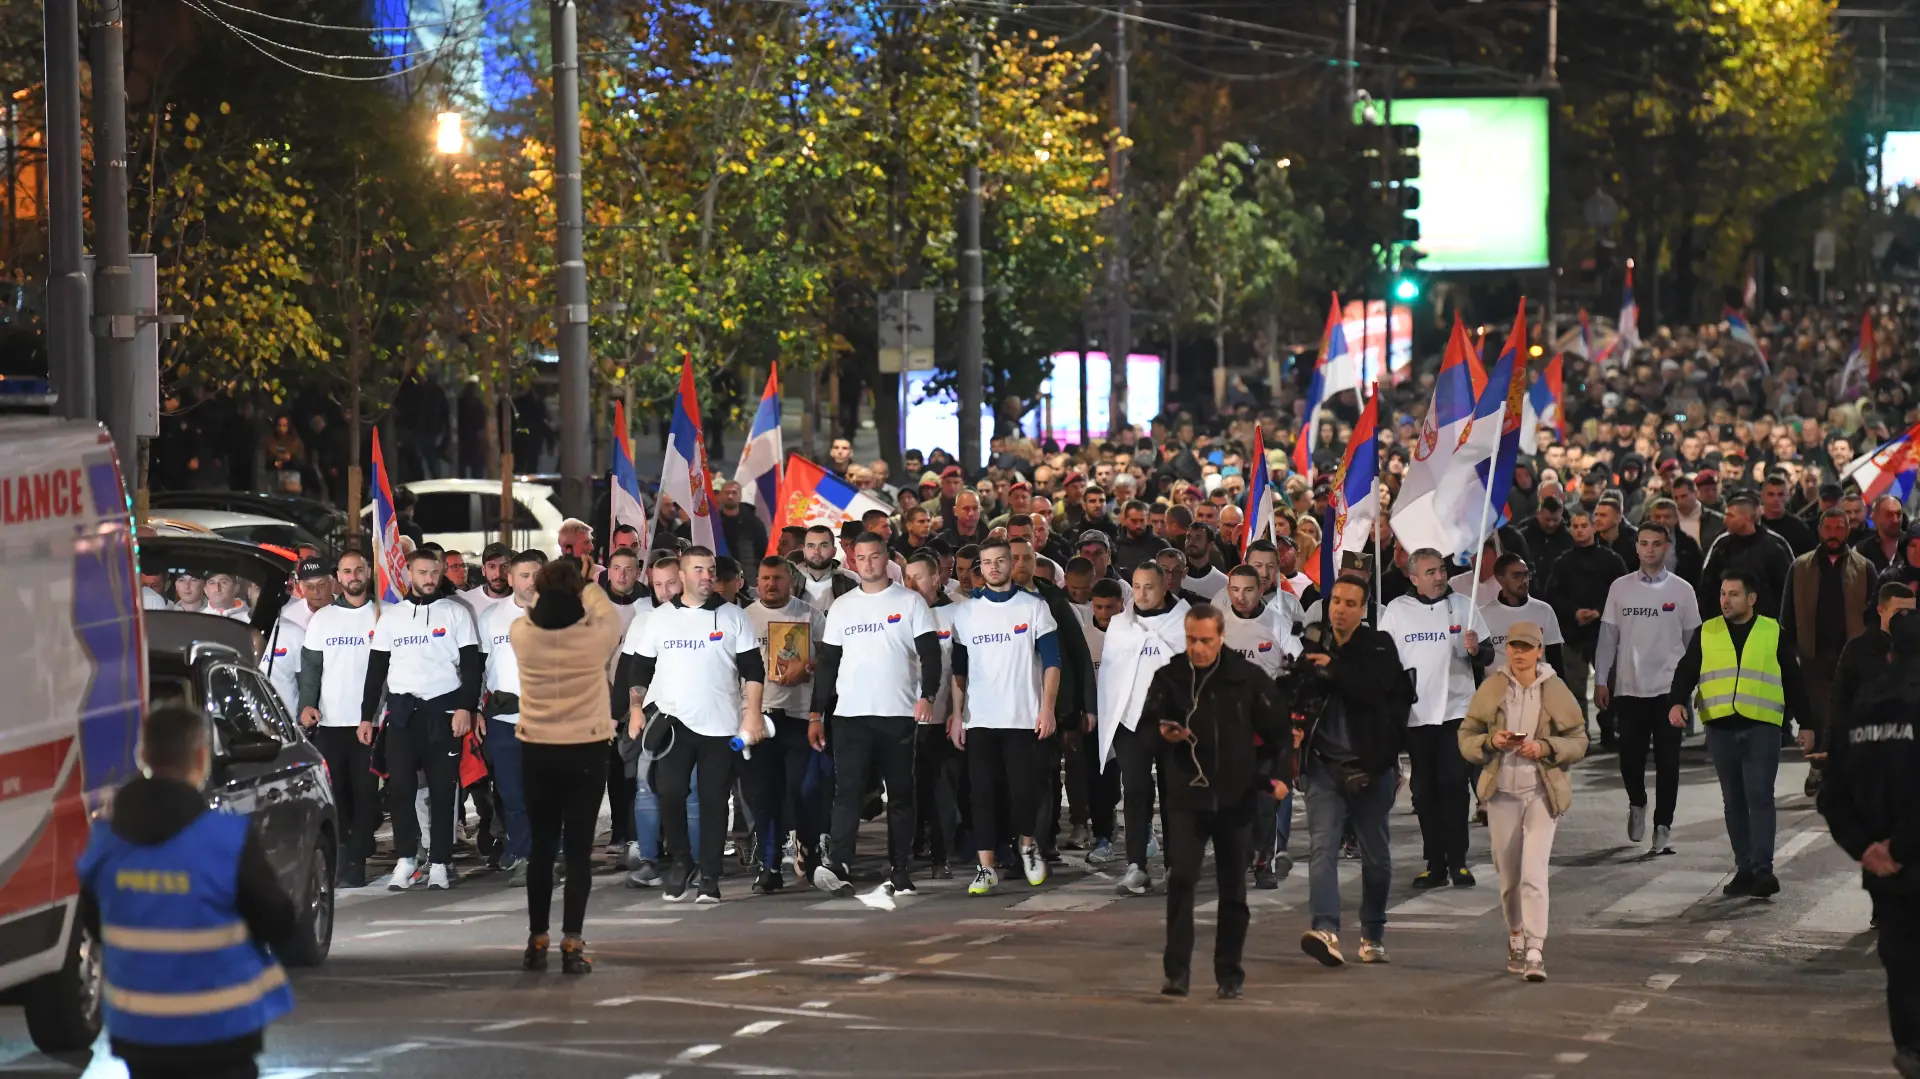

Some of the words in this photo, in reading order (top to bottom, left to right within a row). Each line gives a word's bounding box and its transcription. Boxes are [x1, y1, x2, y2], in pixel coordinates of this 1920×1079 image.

[0, 469, 83, 525] LANCE
[1622, 607, 1659, 617] СРБИЈА
[844, 622, 885, 636] СРБИЈА
[326, 636, 365, 646] СРБИЈА
[393, 635, 429, 647] СРБИЈА
[972, 632, 1011, 645] СРБИЈА
[1404, 632, 1446, 643] СРБИЈА
[663, 639, 705, 650] СРБИЈА
[115, 869, 190, 895] PRESS
